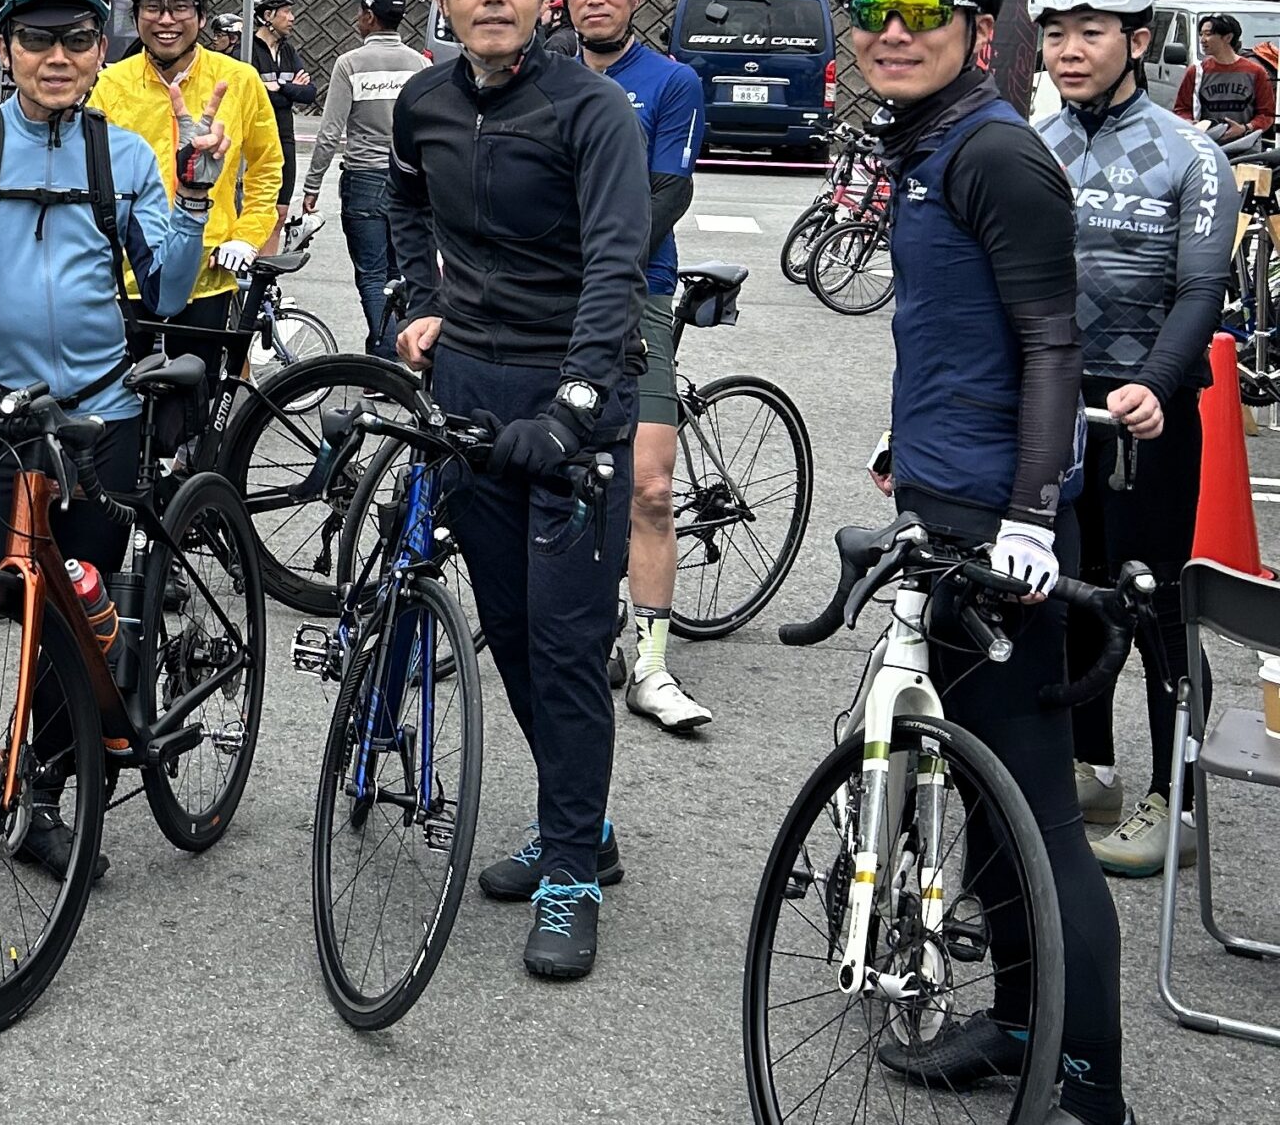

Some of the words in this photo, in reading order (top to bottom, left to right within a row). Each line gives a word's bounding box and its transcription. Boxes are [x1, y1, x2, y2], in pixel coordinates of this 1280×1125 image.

[688, 35, 739, 44] GIANT
[742, 34, 767, 45] Liv
[770, 37, 819, 47] CADEX
[1205, 82, 1230, 97] TROY
[1107, 166, 1136, 185] HS
[1176, 128, 1218, 237] HURRYS
[1088, 216, 1164, 234] SHIRAISHI
[214, 391, 232, 432] OSTRO
